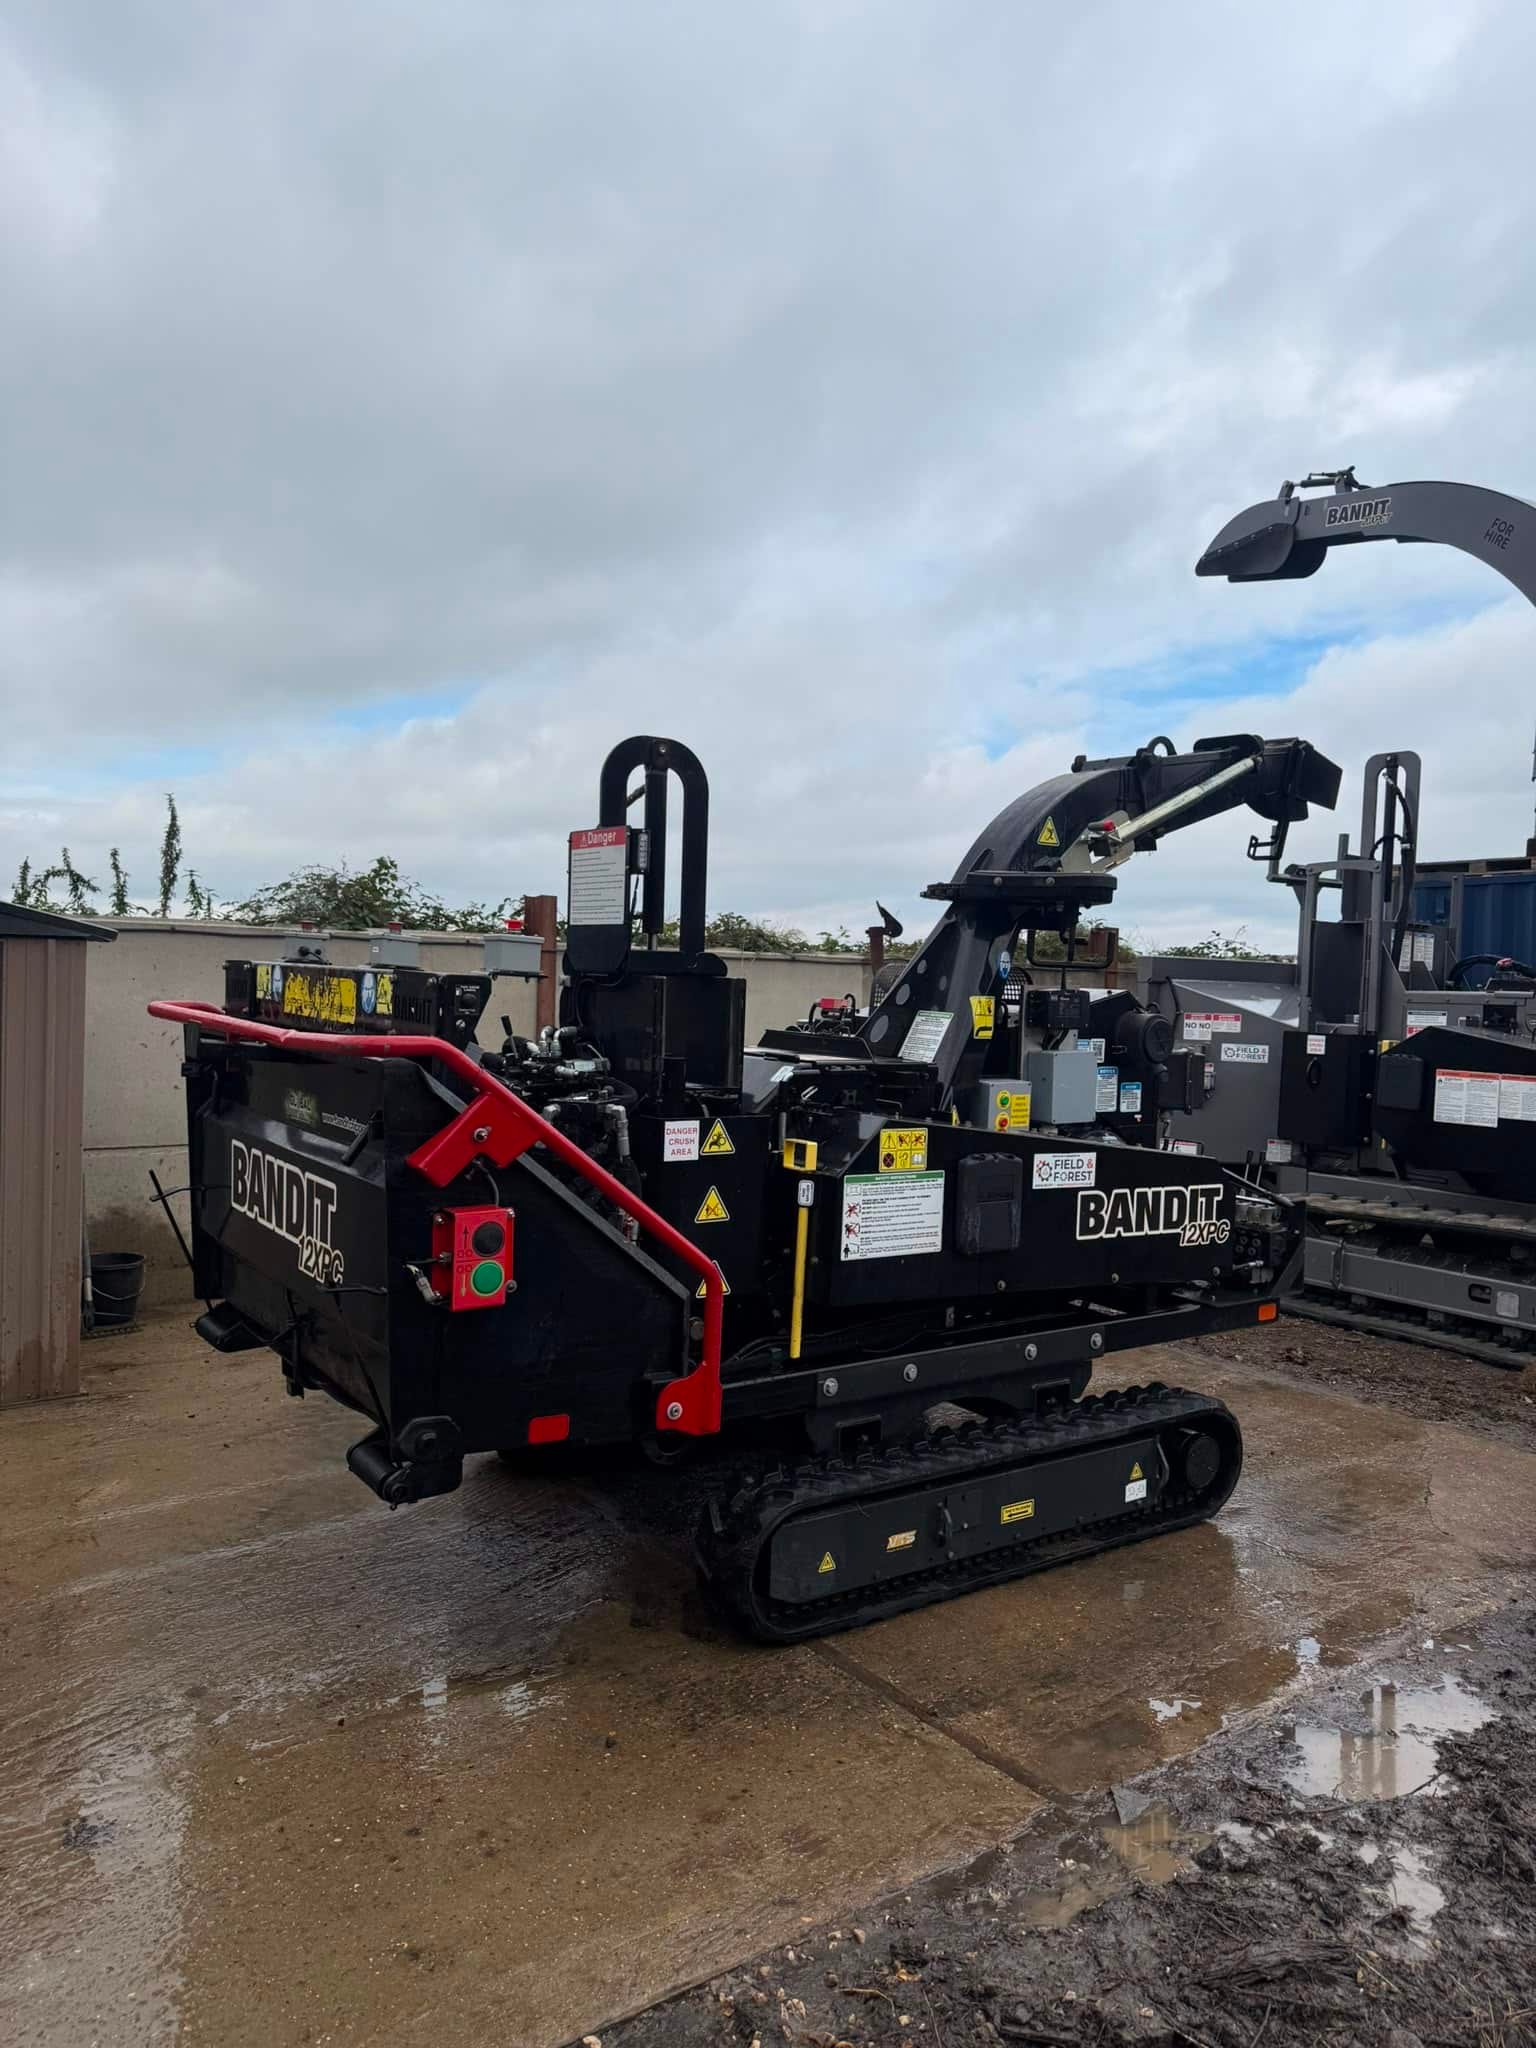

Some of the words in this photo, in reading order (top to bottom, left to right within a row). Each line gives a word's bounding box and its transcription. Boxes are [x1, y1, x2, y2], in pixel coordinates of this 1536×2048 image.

[1325, 497, 1392, 527] BANDIT
[1491, 517, 1514, 537] FOR
[1484, 529, 1510, 550] HIRE
[587, 831, 617, 846] Danger
[665, 1127, 698, 1136] DANGER
[668, 1138, 695, 1146] CRUSH
[671, 1148, 692, 1156] AREA
[1054, 1158, 1085, 1170] FIELD
[1087, 1158, 1094, 1169] &
[1053, 1171, 1093, 1182] FOREST
[232, 1139, 337, 1248] BANDIT
[1076, 1184, 1223, 1240] BANDIT
[1179, 1219, 1231, 1247] 12XPC
[298, 1236, 344, 1284] 12XPC
